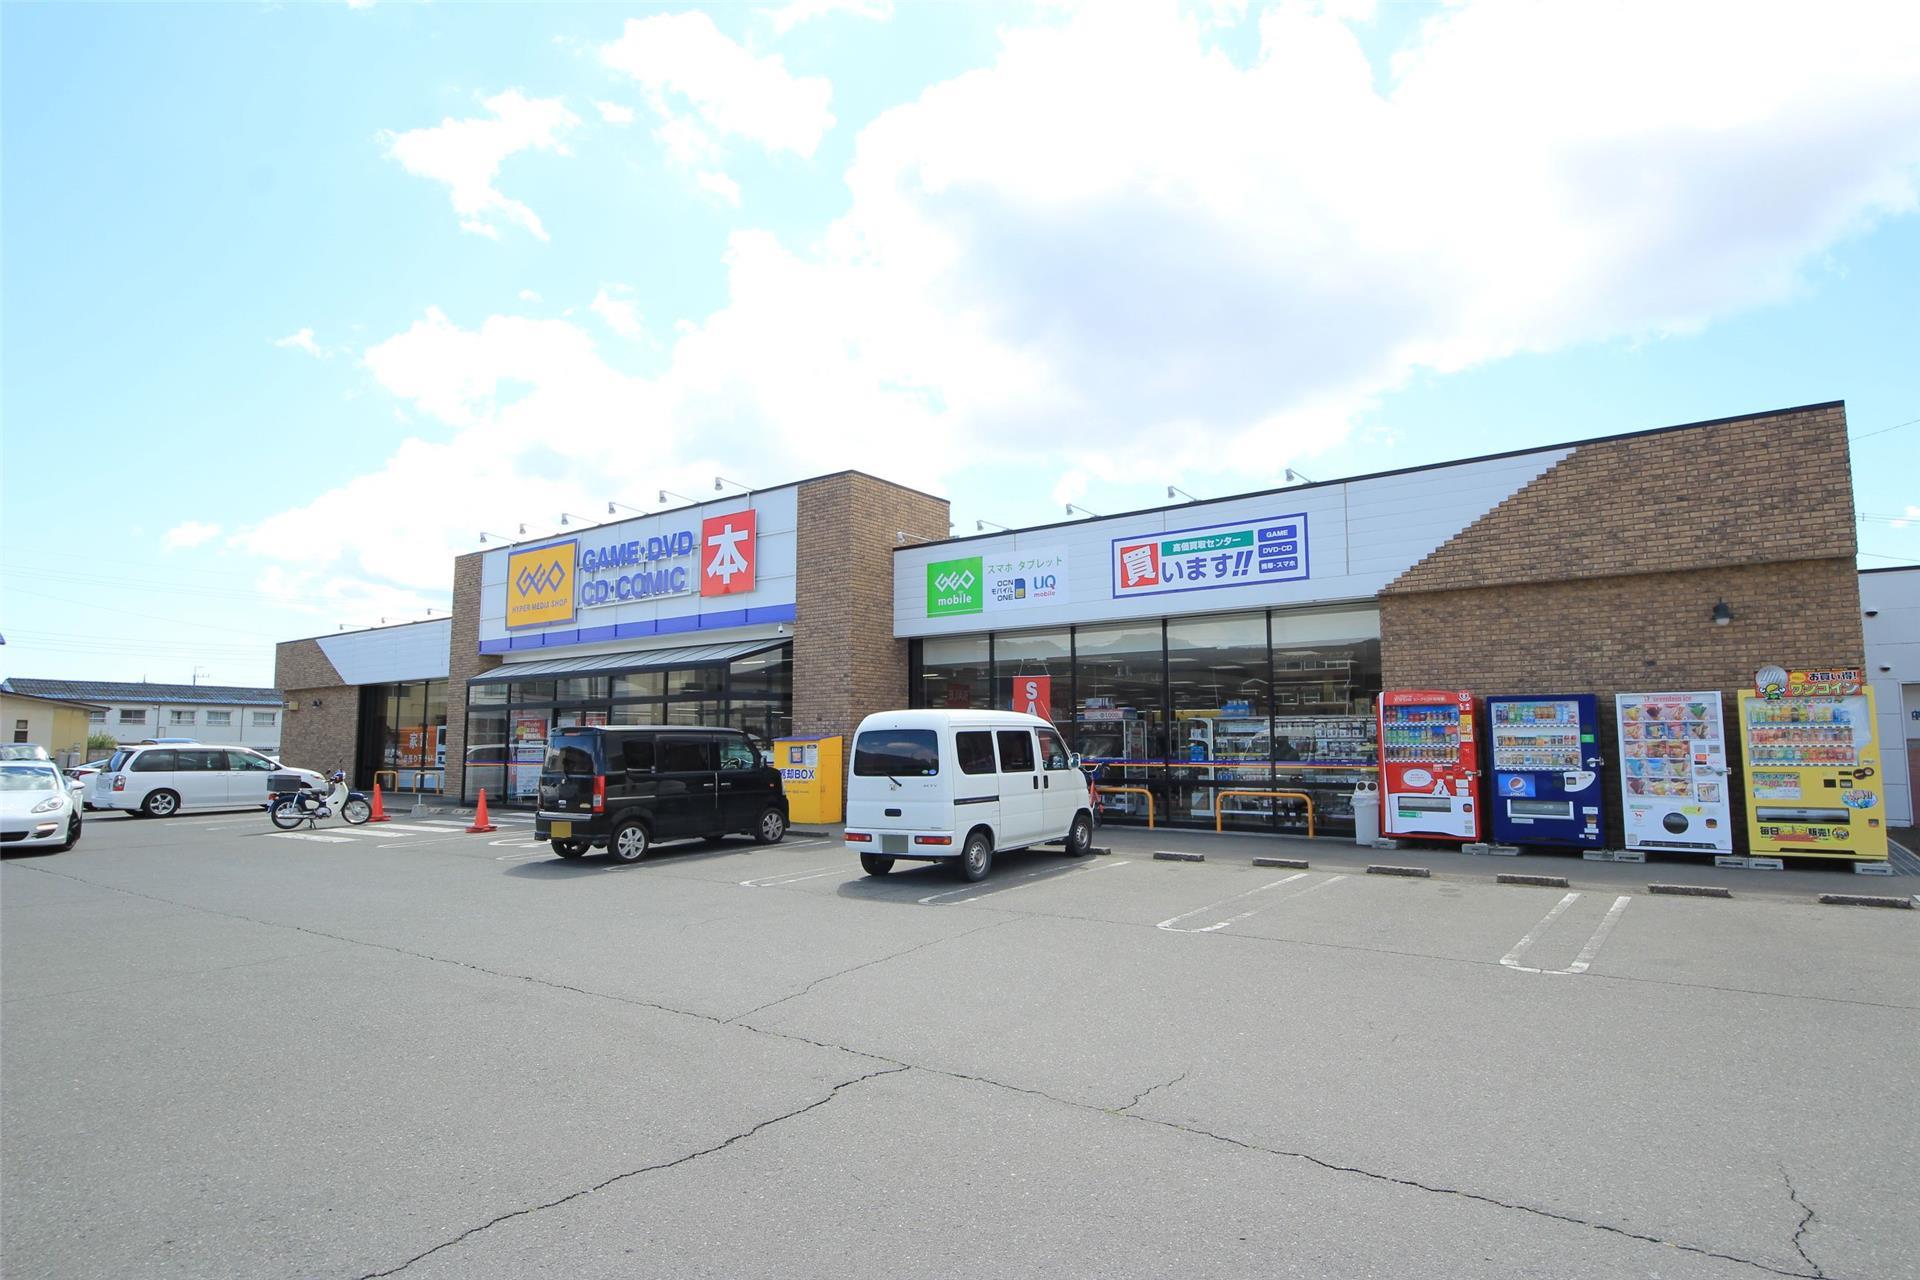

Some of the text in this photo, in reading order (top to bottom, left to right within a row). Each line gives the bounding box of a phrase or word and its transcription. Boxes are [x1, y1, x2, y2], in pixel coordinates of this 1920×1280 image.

[1266, 529, 1289, 538] GAME
[1172, 536, 1242, 553] 高価買取センター
[707, 524, 749, 585] 本
[987, 555, 1063, 574] スマホ タブレット
[997, 579, 1014, 587] OCN
[1033, 574, 1057, 590] UQ
[992, 587, 1014, 595] モバイル
[997, 593, 1014, 602] ONE
[1033, 590, 1056, 598] mobile
[512, 598, 568, 614] HYPER MEDIA SHOP
[938, 592, 973, 606] mobile
[1809, 671, 1857, 681] お買い得!
[1790, 682, 1860, 696] ワンコイン
